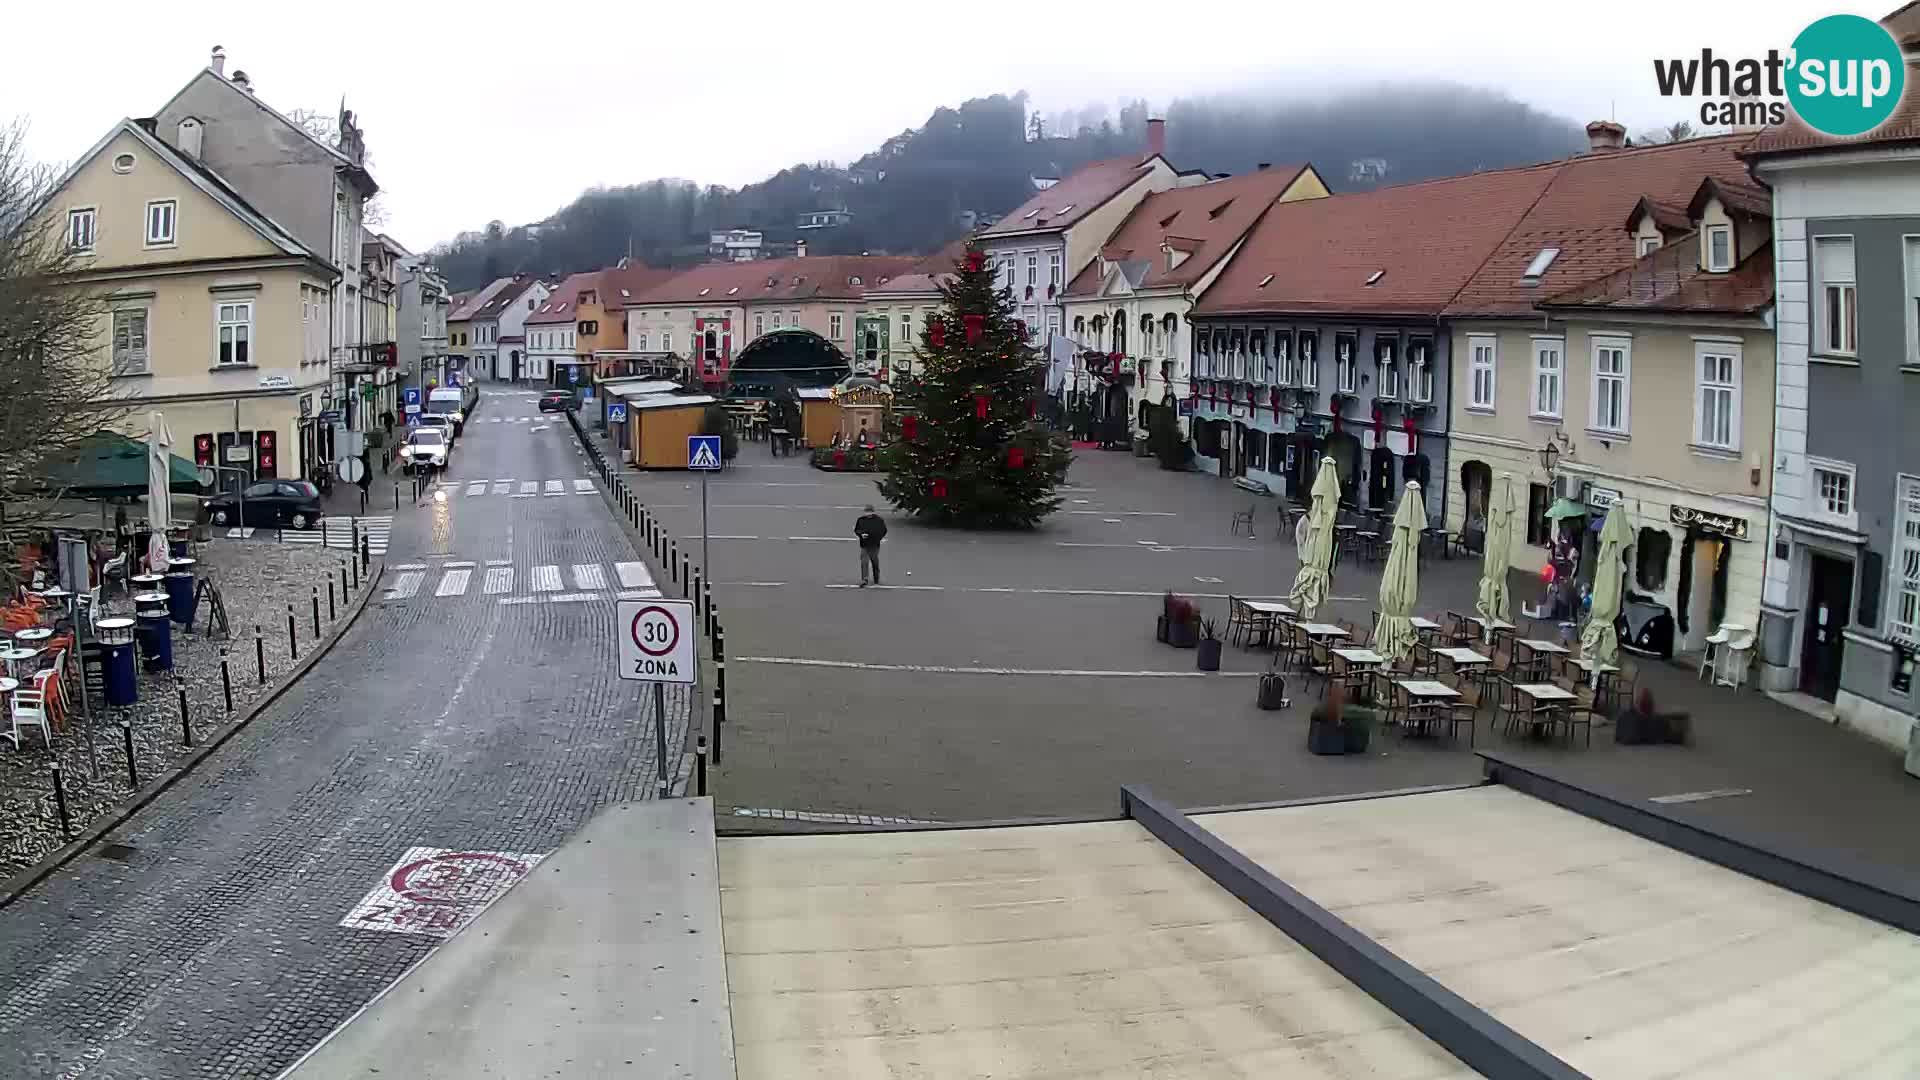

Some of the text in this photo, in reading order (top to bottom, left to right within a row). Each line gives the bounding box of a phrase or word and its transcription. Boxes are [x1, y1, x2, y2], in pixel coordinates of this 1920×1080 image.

[409, 392, 417, 402] P
[644, 622, 668, 642] 30
[634, 659, 678, 675] ZONA
